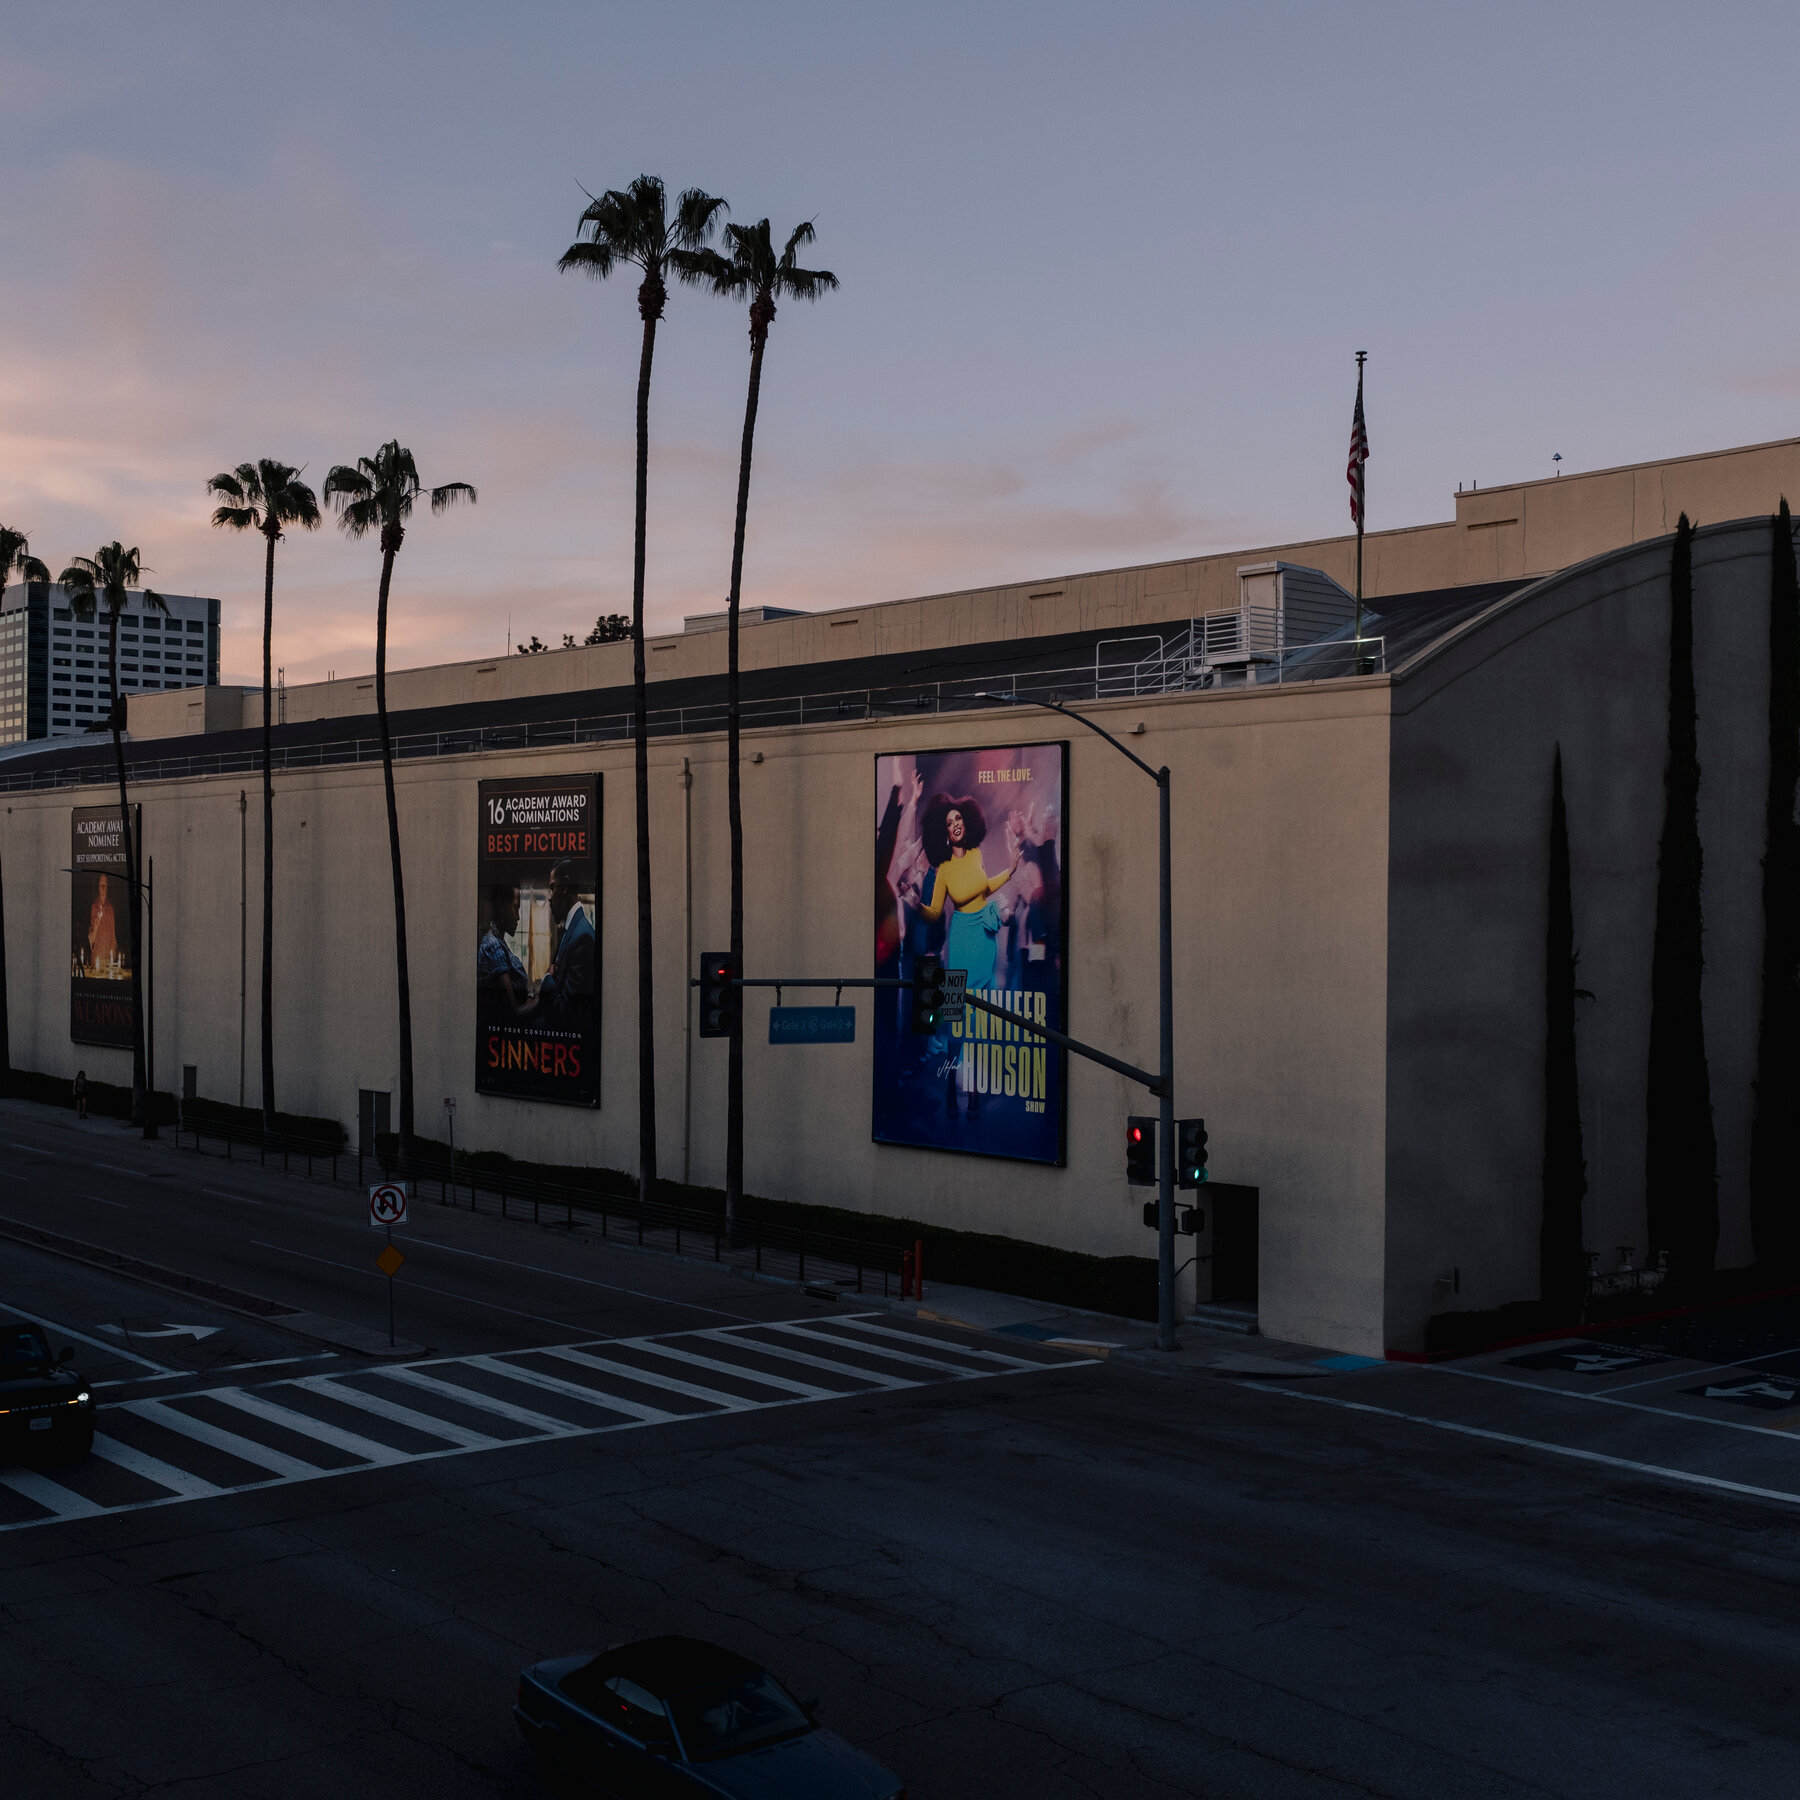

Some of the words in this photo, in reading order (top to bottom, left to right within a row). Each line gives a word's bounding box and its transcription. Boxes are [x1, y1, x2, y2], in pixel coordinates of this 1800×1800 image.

[978, 770, 995, 784] FEEL
[997, 769, 1011, 782] THE
[1012, 768, 1033, 782] LOVE.
[505, 797, 551, 811] ACADEMY
[551, 794, 587, 809] AWARD
[488, 798, 505, 824] 16
[511, 809, 580, 823] NOMINATIONS
[77, 820, 106, 834] ACADEMY
[88, 834, 120, 848] NOMINEE
[487, 834, 519, 853] BEST
[524, 832, 586, 853] PICTURE
[948, 975, 965, 987] NOT
[944, 992, 963, 1004] OCK
[524, 1028, 582, 1039] CONSIDERATION
[488, 1035, 581, 1077] SINNERS
[963, 1042, 1046, 1099] HUDSON
[1025, 1101, 1045, 1114] SHOW
